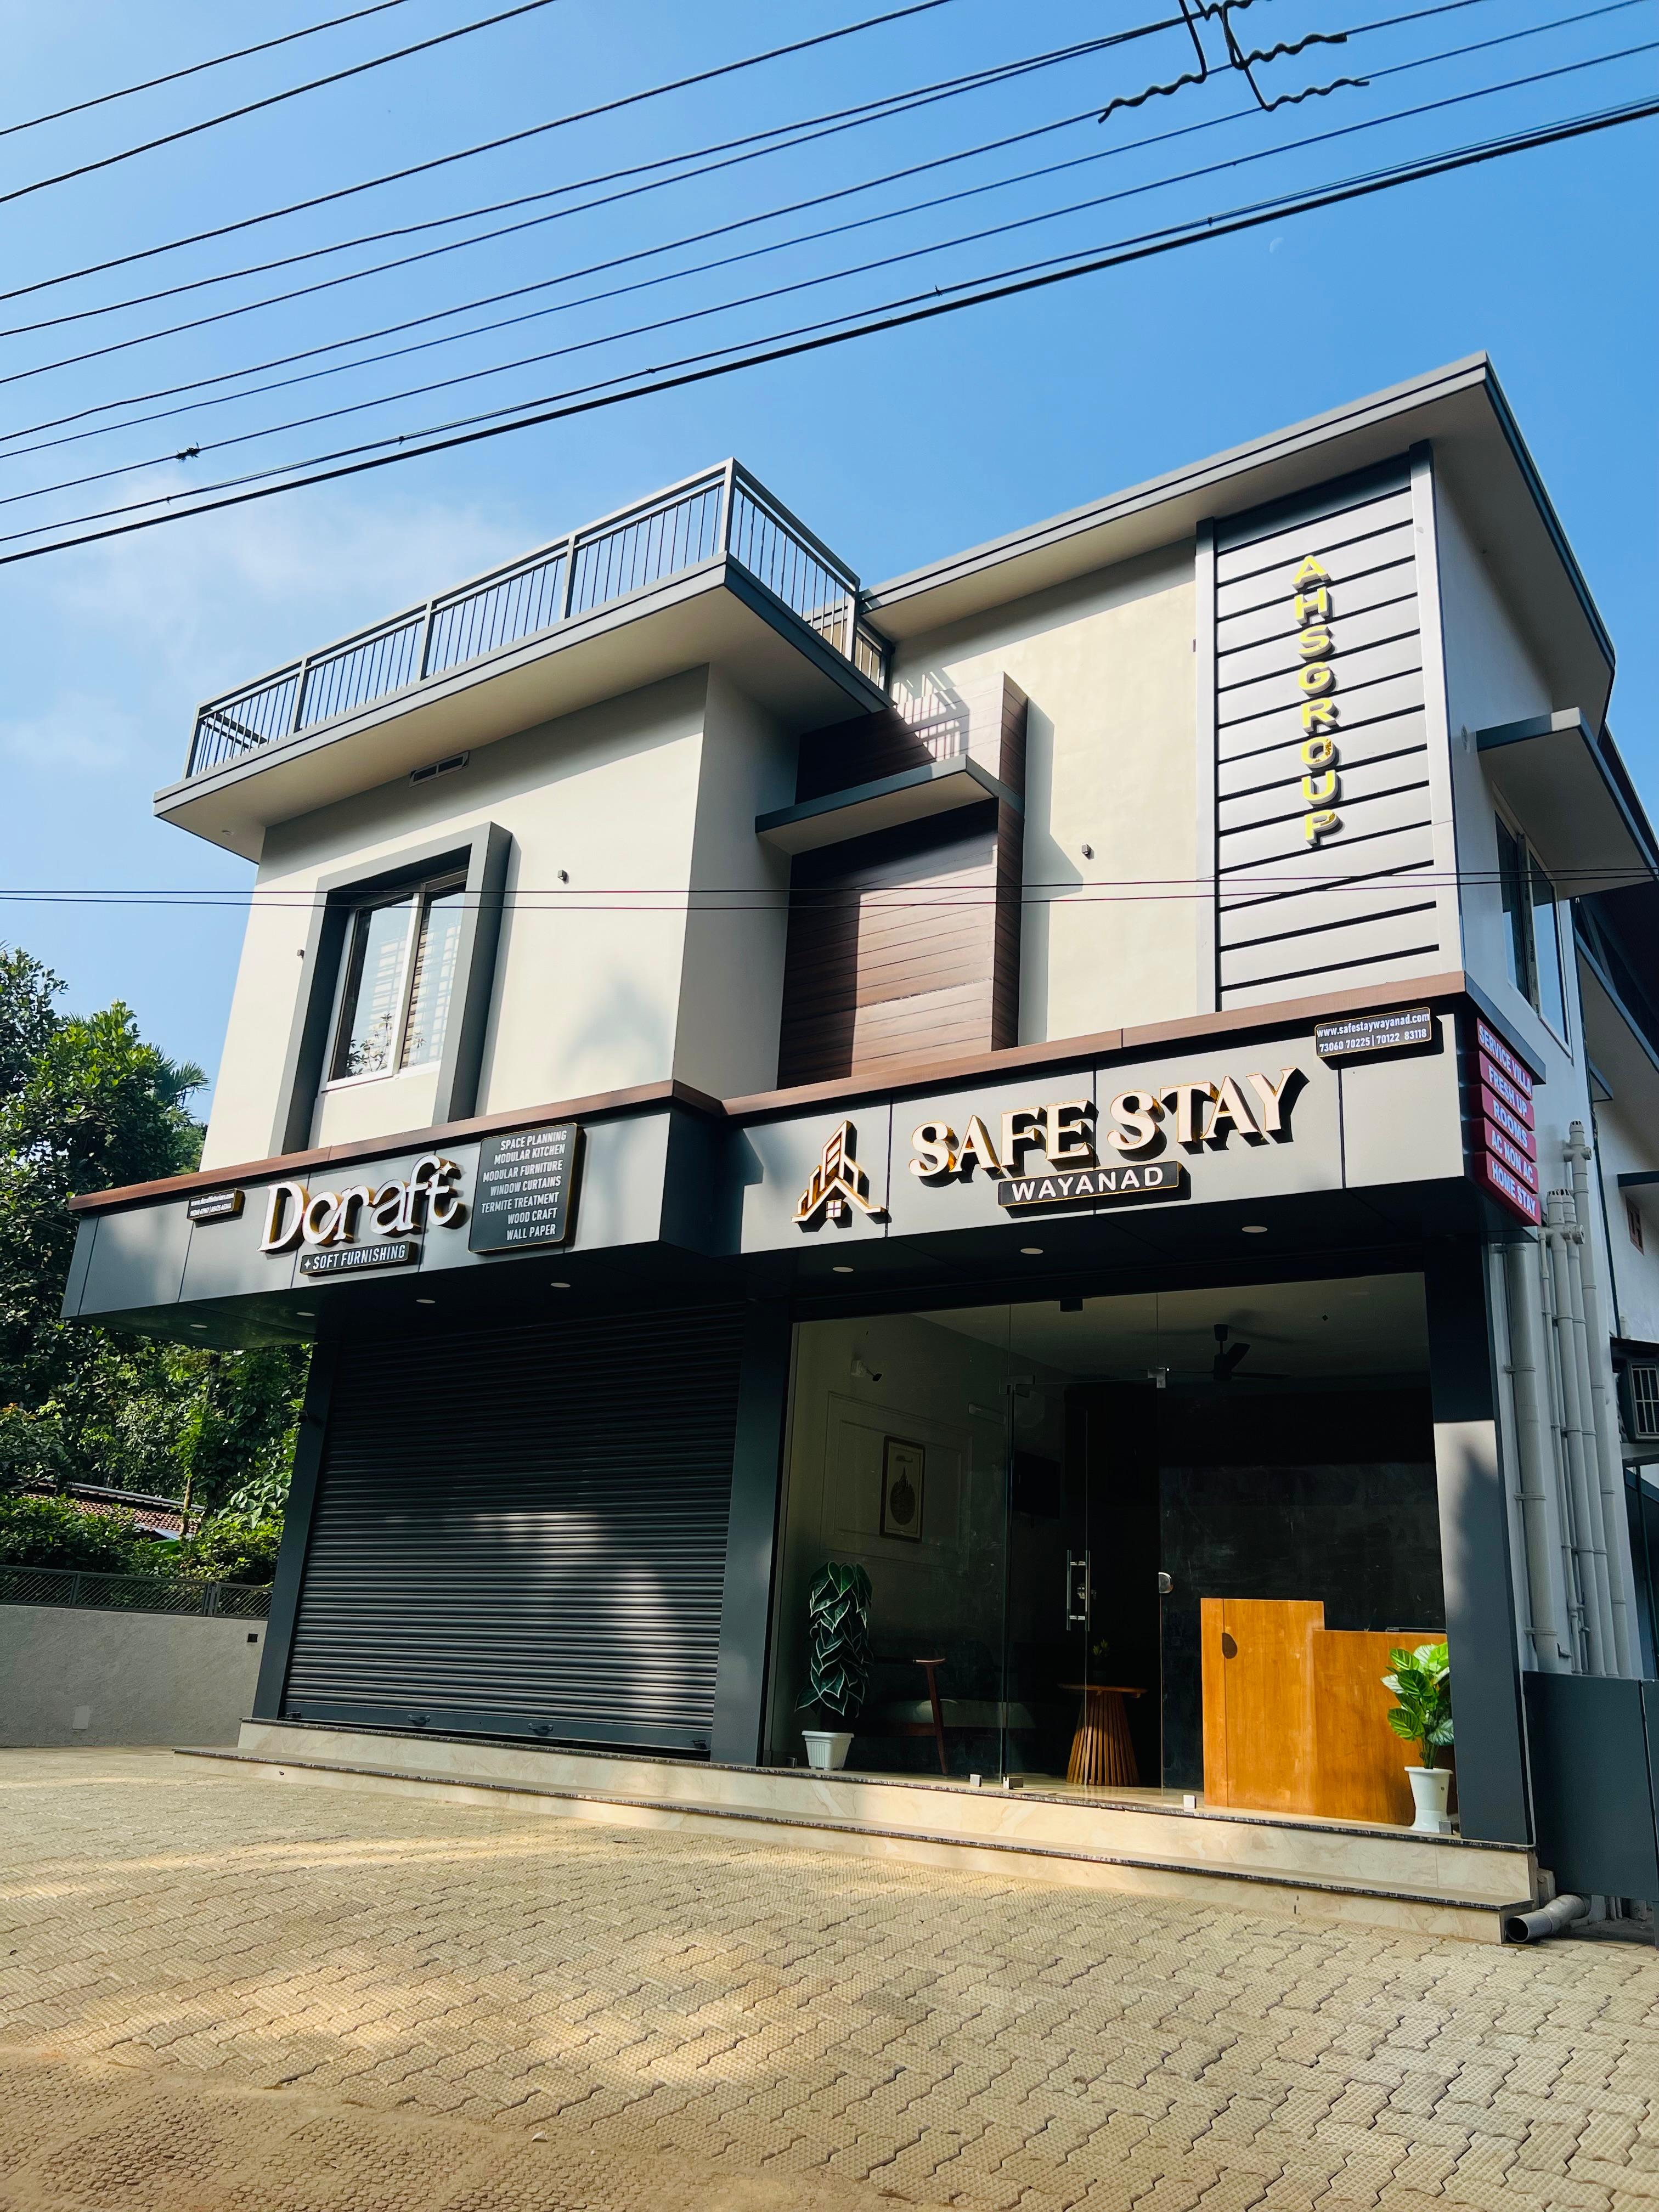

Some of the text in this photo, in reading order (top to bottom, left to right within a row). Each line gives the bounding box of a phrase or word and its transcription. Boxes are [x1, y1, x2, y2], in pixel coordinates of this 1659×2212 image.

[1317, 1013, 1430, 1037] www.safestaywayanad.com
[1319, 1041, 1344, 1052] 73060
[1346, 1037, 1370, 1049] 70225
[1376, 1032, 1400, 1044] 70122
[1404, 1029, 1427, 1040] 83118
[1479, 1025, 1532, 1096] SERVICE VILLA
[1488, 1065, 1527, 1118] FRESH UP
[909, 1067, 1299, 1177] SAFE STAY
[1493, 1099, 1528, 1148] ROOMS
[500, 1130, 567, 1151] SPACE PLANNING
[494, 1143, 565, 1165] MODULAR KITCHEN
[1492, 1130, 1533, 1184] AC NON AC
[483, 1160, 563, 1182] MODULAR FURNITURE
[490, 1176, 561, 1196] WINDOW CURTAINS
[1012, 1165, 1164, 1203] WAYANAD
[1492, 1161, 1536, 1216] HOME STAY
[481, 1192, 560, 1214] TERMITE TREATMENT
[508, 1207, 557, 1224] WOOD CRAFT
[507, 1224, 556, 1240] WALL PAPER
[312, 1245, 405, 1270] SOFT FURNISHING
